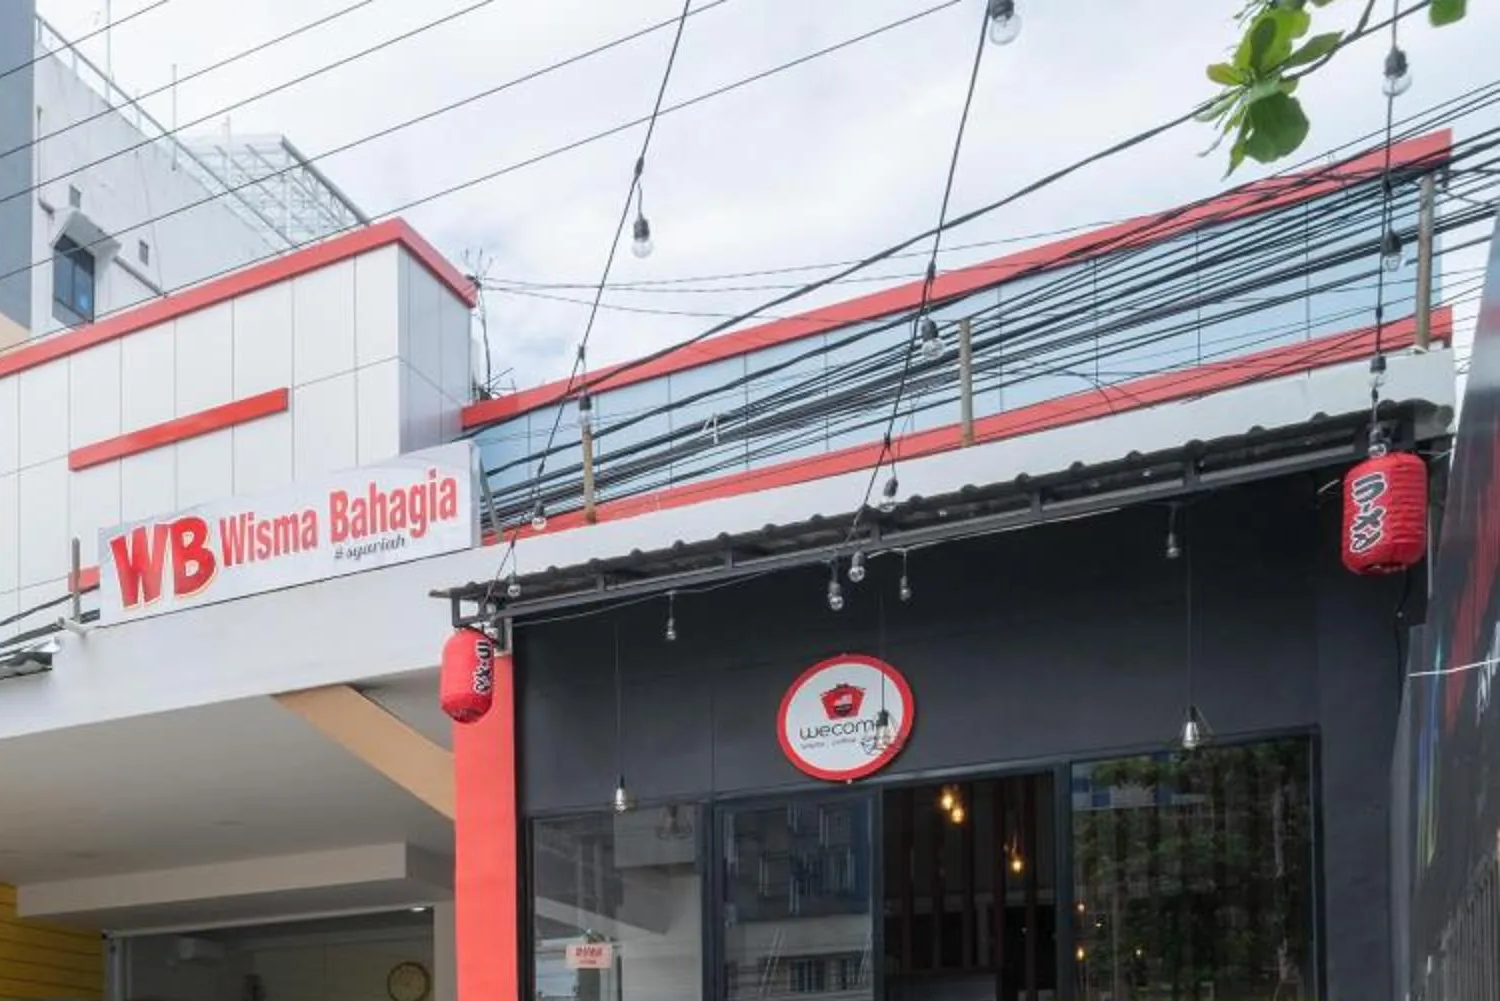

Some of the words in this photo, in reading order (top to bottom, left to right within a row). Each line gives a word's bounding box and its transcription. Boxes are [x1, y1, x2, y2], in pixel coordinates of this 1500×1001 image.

[109, 516, 217, 609] WB
[219, 507, 318, 567] Wisma
[328, 468, 458, 543] Bahagia
[800, 717, 886, 740] wecom
